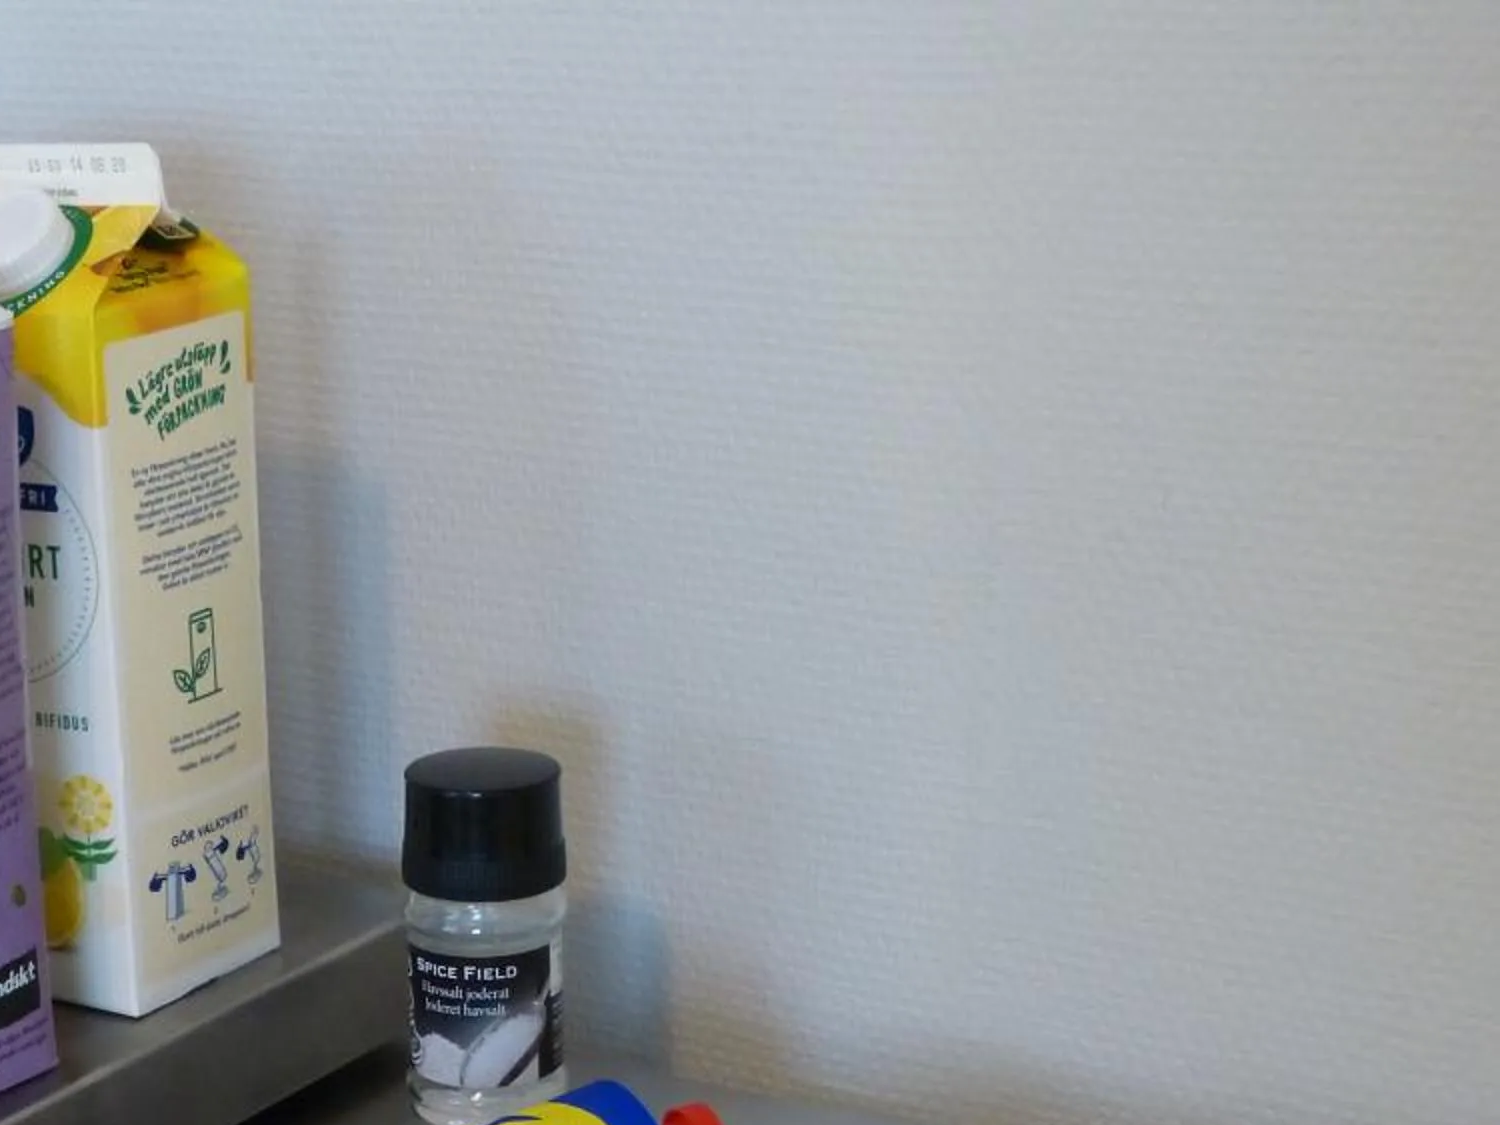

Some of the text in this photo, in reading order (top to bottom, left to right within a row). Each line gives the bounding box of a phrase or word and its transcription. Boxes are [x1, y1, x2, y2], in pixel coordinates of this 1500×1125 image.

[34, 710, 90, 733] BIFIDUS
[416, 956, 518, 982] SPICE FIELD
